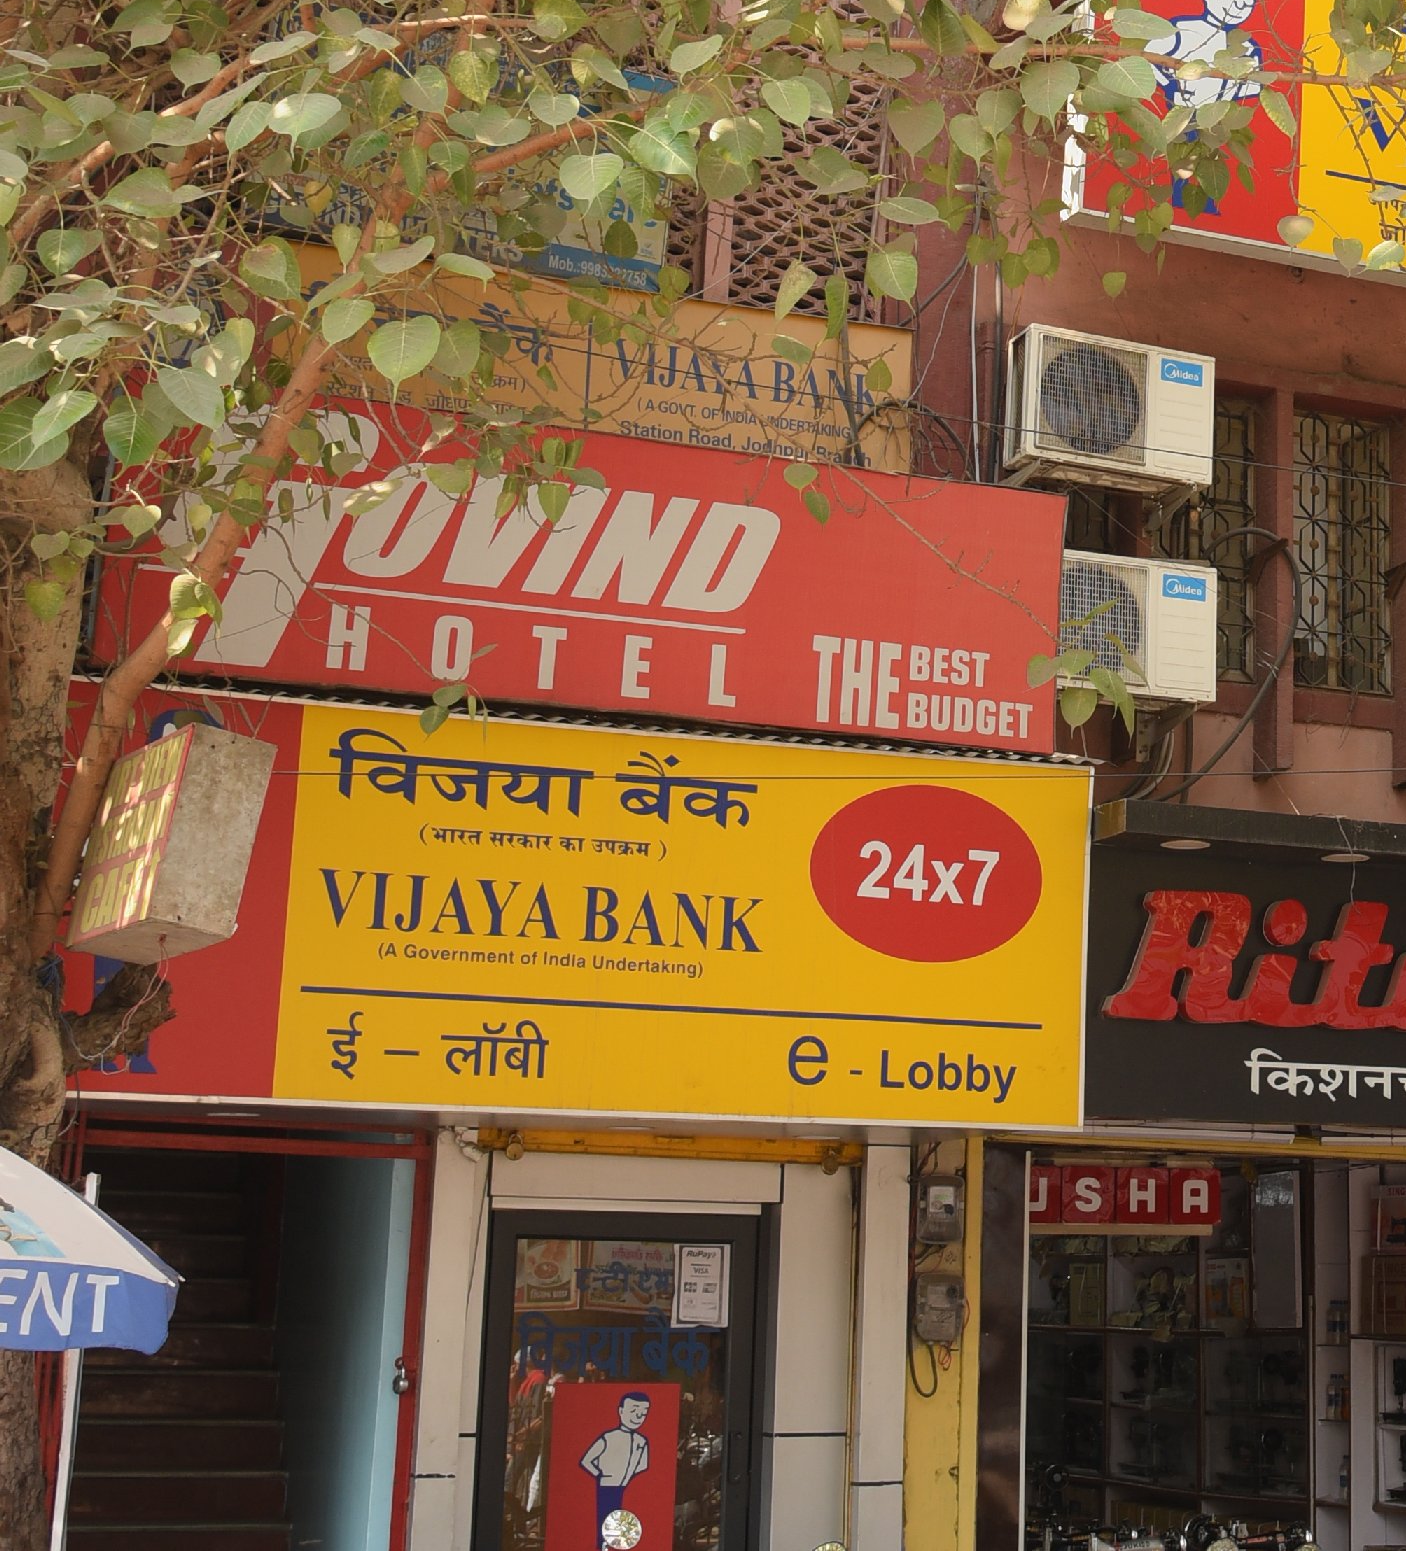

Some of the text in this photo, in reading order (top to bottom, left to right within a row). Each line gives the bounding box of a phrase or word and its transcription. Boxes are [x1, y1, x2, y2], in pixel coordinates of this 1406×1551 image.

[616, 337, 758, 401] VIJAYA
[1171, 366, 1200, 381] Midea
[620, 420, 683, 443] Station
[688, 427, 736, 449] Road,
[701, 406, 719, 420] OF
[325, 605, 737, 709] HOTEL
[813, 635, 991, 730] THE BEST
[906, 692, 1034, 740] BUDGET
[329, 728, 758, 829] विजया बैंक
[419, 822, 483, 847] (भारत
[489, 831, 553, 851] सरकार
[559, 836, 586, 853] का
[856, 840, 1000, 907] 24x7
[319, 867, 764, 953] VIJAYA BANK
[377, 942, 704, 978] (A Government of India Undertaking)
[326, 1010, 363, 1081] ई
[440, 1019, 550, 1081] लॉबी
[787, 1034, 829, 1087] e
[879, 1048, 1018, 1104] Lobby
[685, 1248, 711, 1261] RuPay
[517, 1310, 640, 1378] विजया
